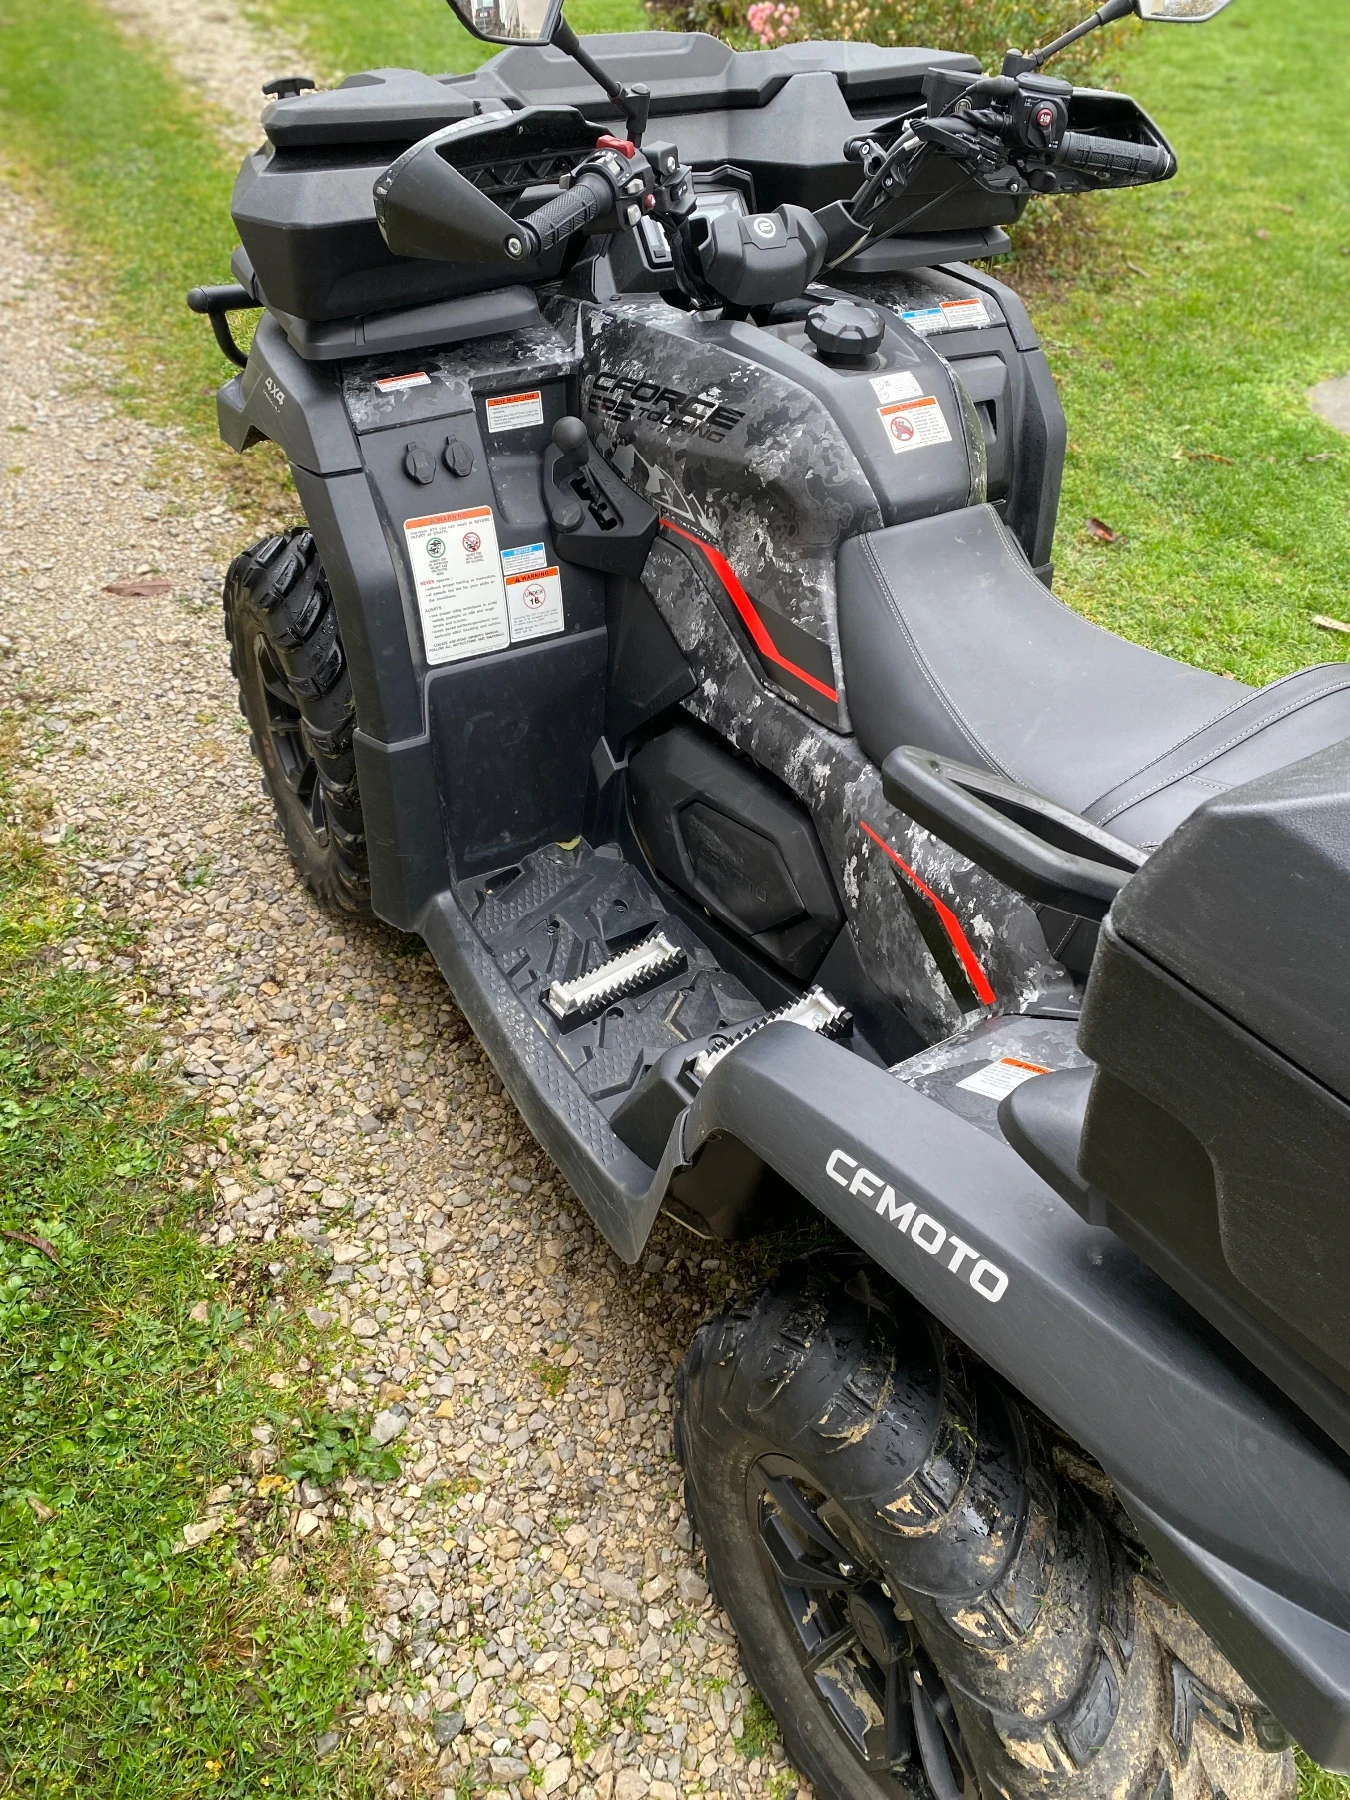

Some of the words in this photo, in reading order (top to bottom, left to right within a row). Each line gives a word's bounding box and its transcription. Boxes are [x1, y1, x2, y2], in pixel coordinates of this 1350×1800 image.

[265, 376, 285, 405] 4X4
[593, 372, 746, 430] CFORCE
[588, 394, 636, 423] EPS
[638, 406, 726, 444] TOURING
[522, 570, 549, 582] WARNING
[825, 1148, 1009, 1303] CFMOTO
